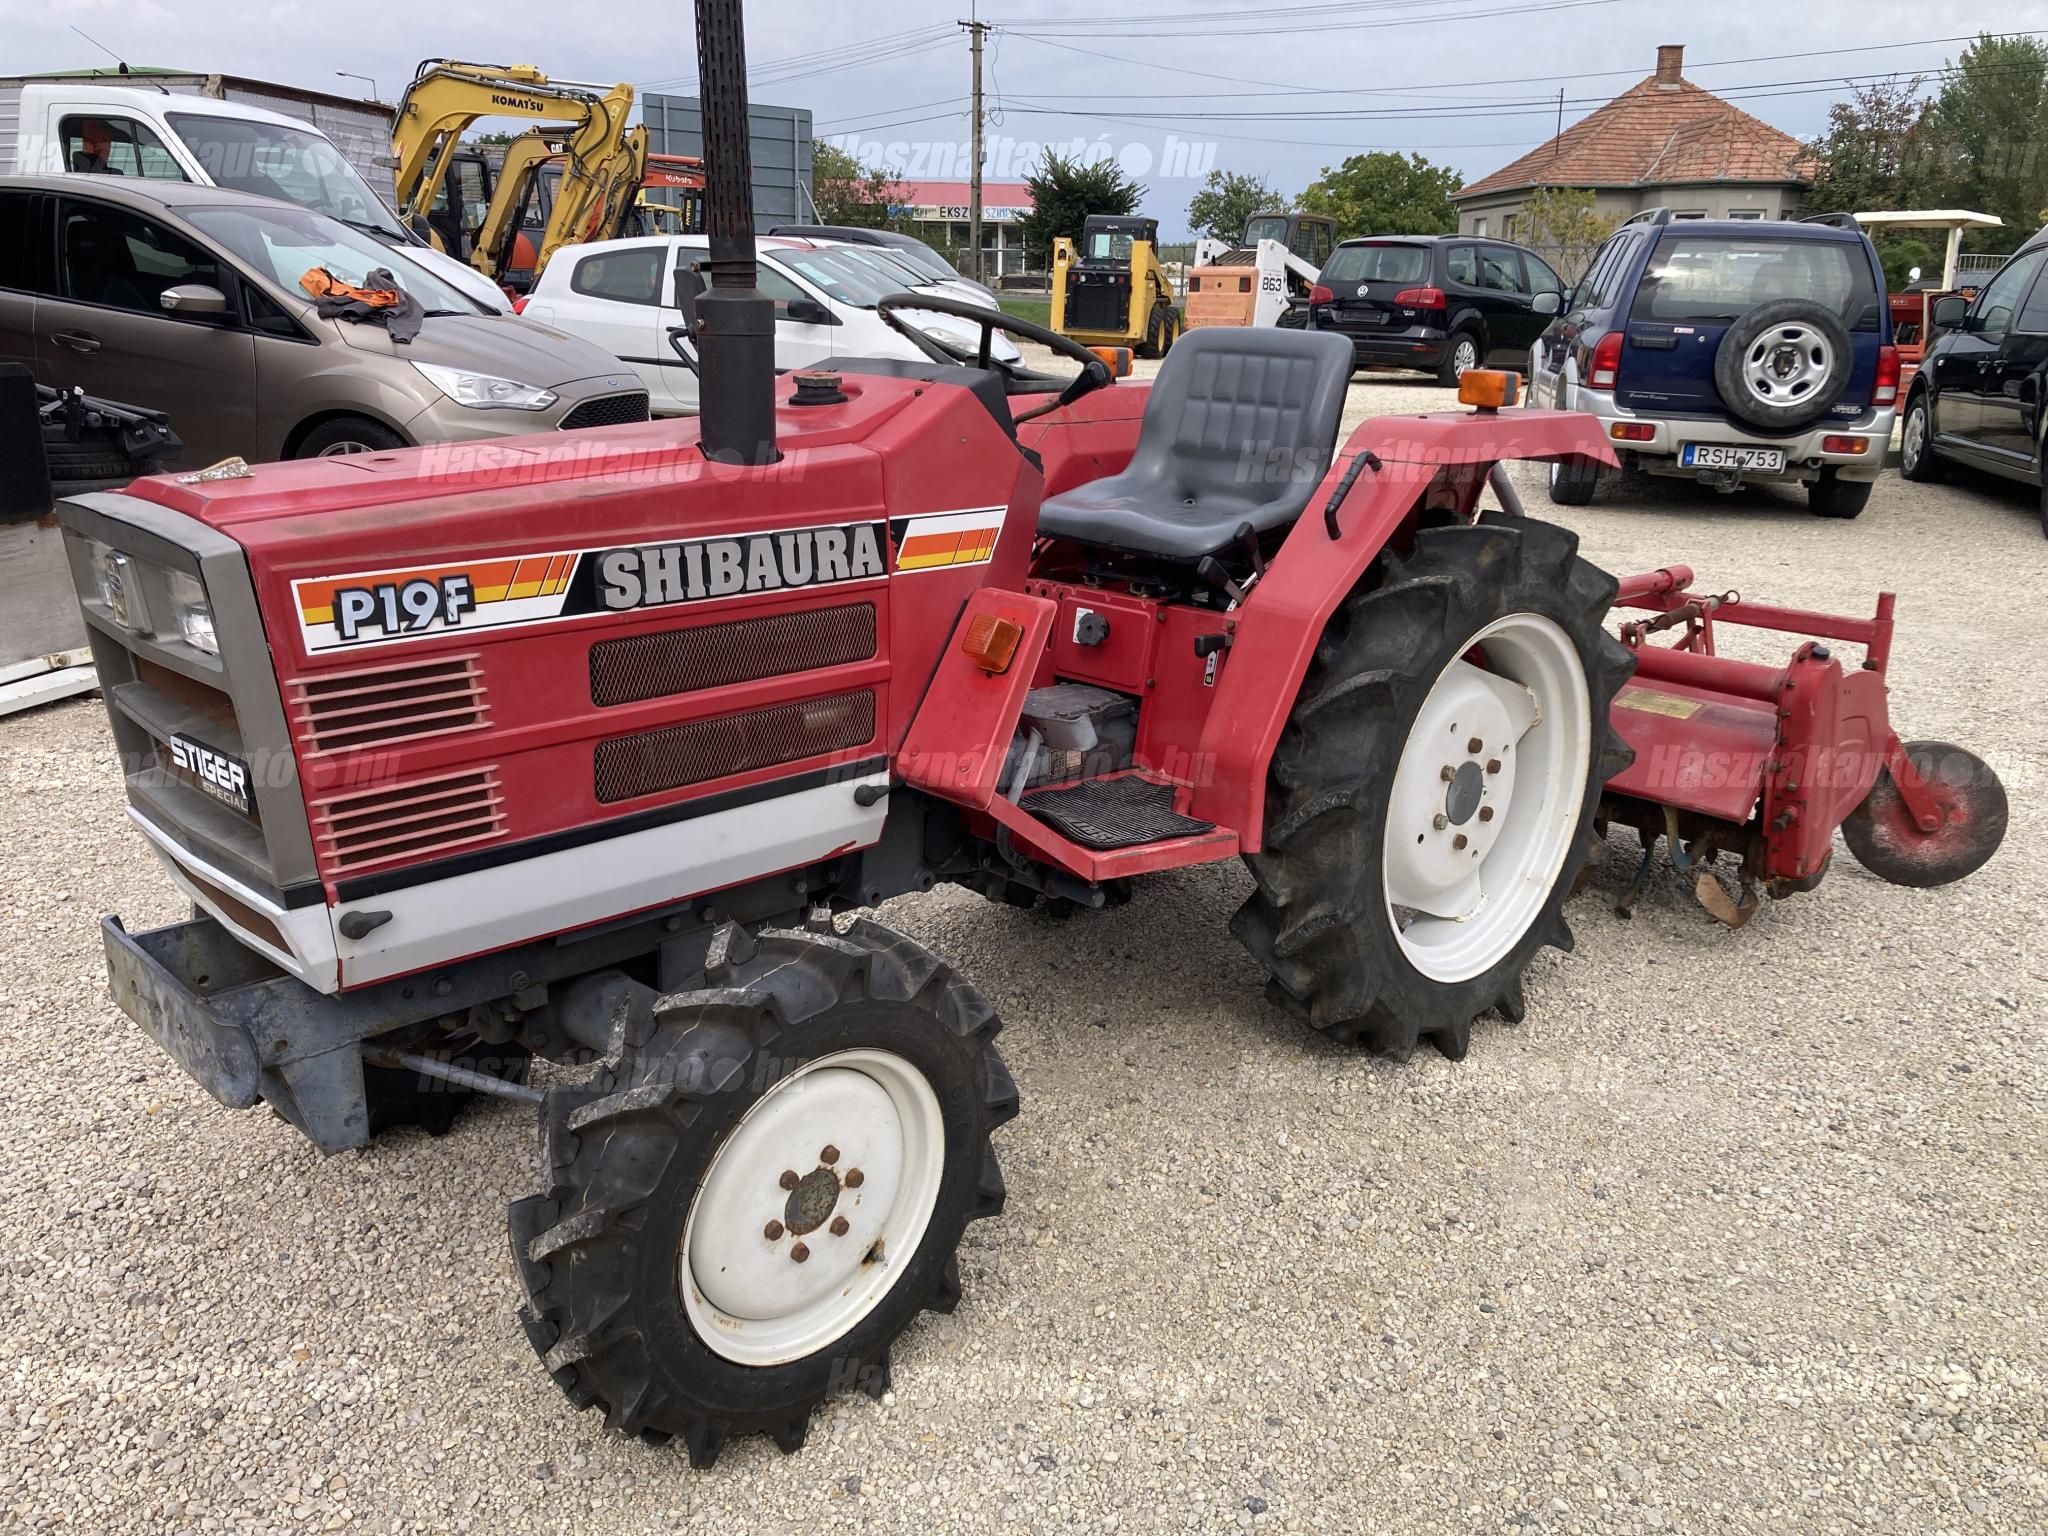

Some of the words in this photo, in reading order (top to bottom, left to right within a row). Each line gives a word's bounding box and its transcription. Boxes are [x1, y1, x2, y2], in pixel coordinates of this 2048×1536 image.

[491, 94, 545, 112] KOMATSU
[550, 143, 564, 154] CAT
[665, 174, 693, 185] Kubota
[939, 206, 972, 218] EKSZ
[1262, 276, 1283, 292] 863
[602, 523, 884, 610] SHIBAURA
[336, 576, 474, 641] P19F
[170, 735, 248, 799] STIGER
[202, 782, 248, 812] SPECIAL
